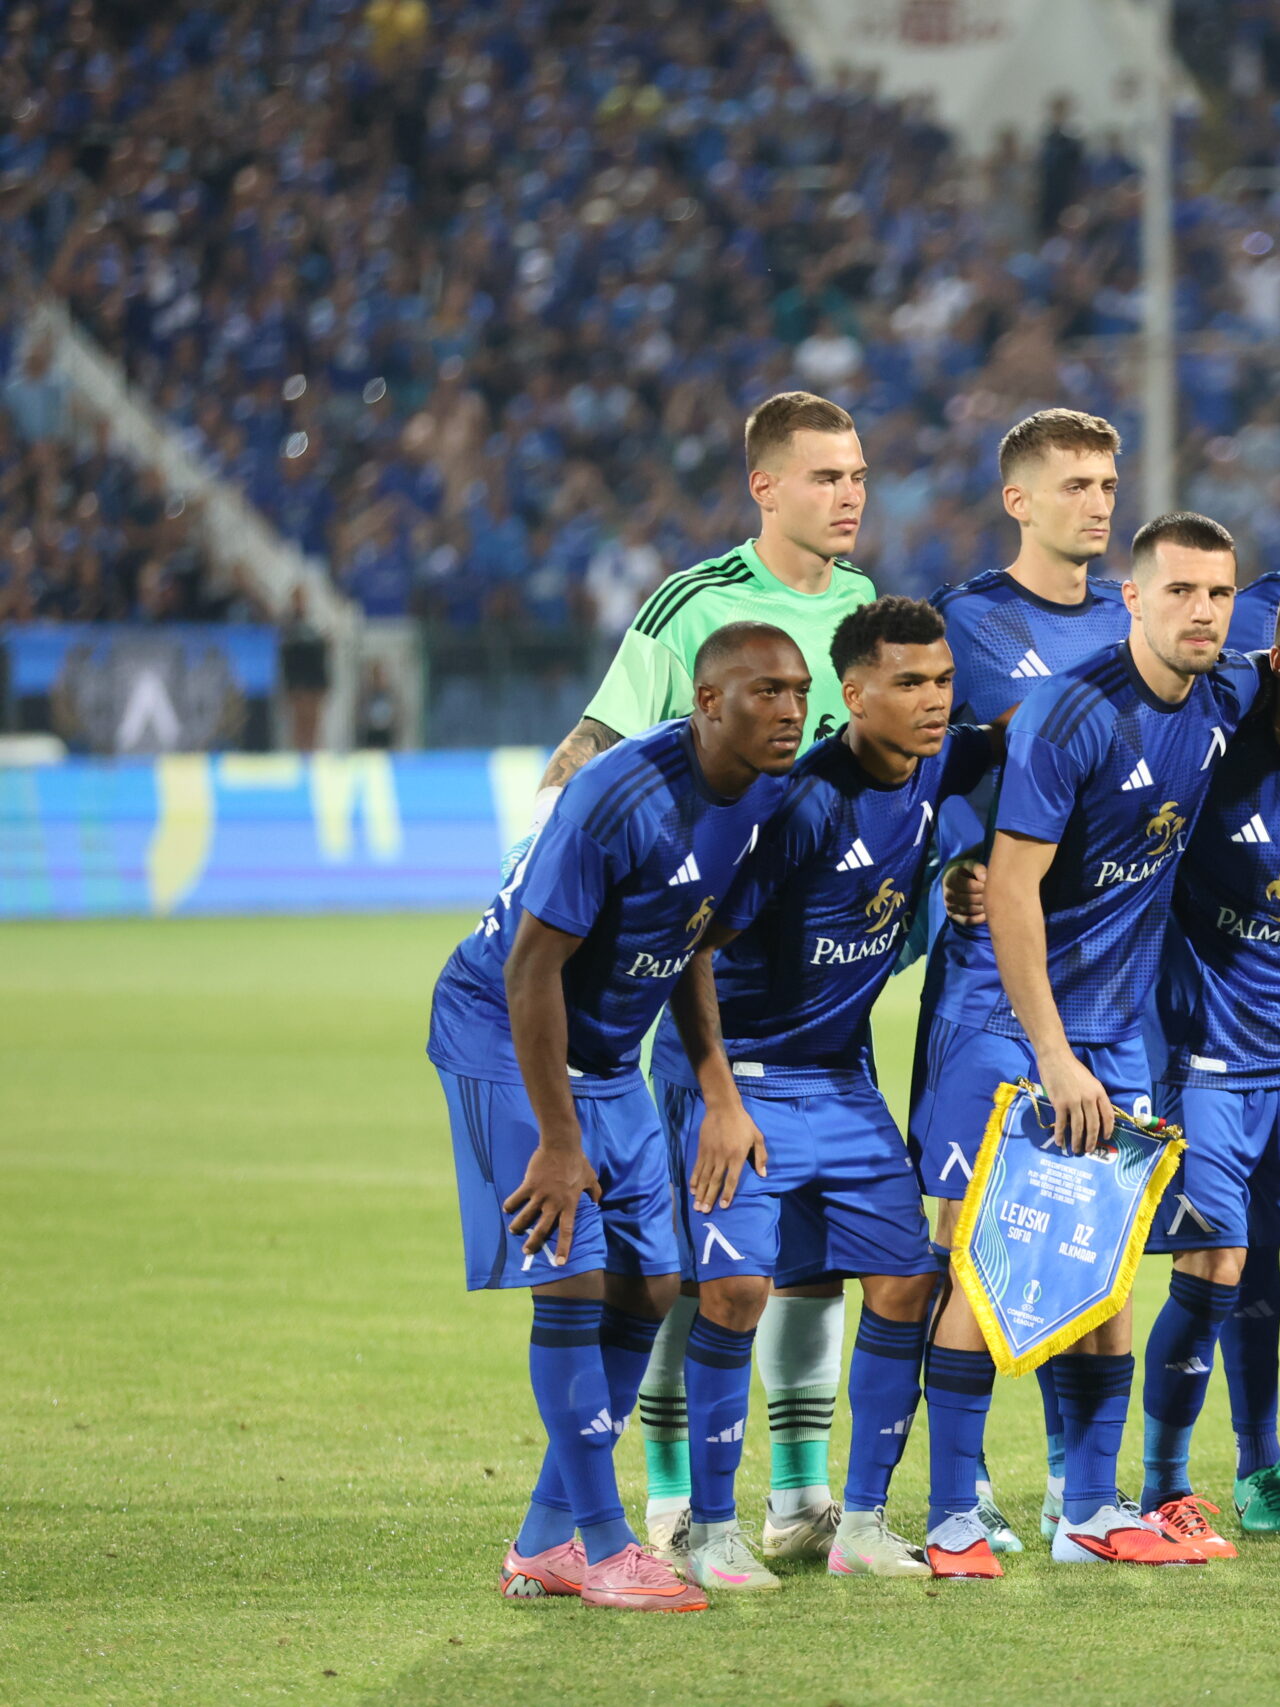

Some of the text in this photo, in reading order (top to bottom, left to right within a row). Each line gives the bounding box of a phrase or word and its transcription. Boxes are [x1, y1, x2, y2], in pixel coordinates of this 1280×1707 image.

[1094, 861, 1165, 887] PALM
[626, 950, 695, 978] PALM
[810, 937, 889, 965] PALMS
[1000, 1200, 1050, 1233] LEVSKI
[1007, 1226, 1032, 1244] SOFIA
[1072, 1223, 1095, 1247] AZ
[1058, 1242, 1097, 1265] ALKMAAR
